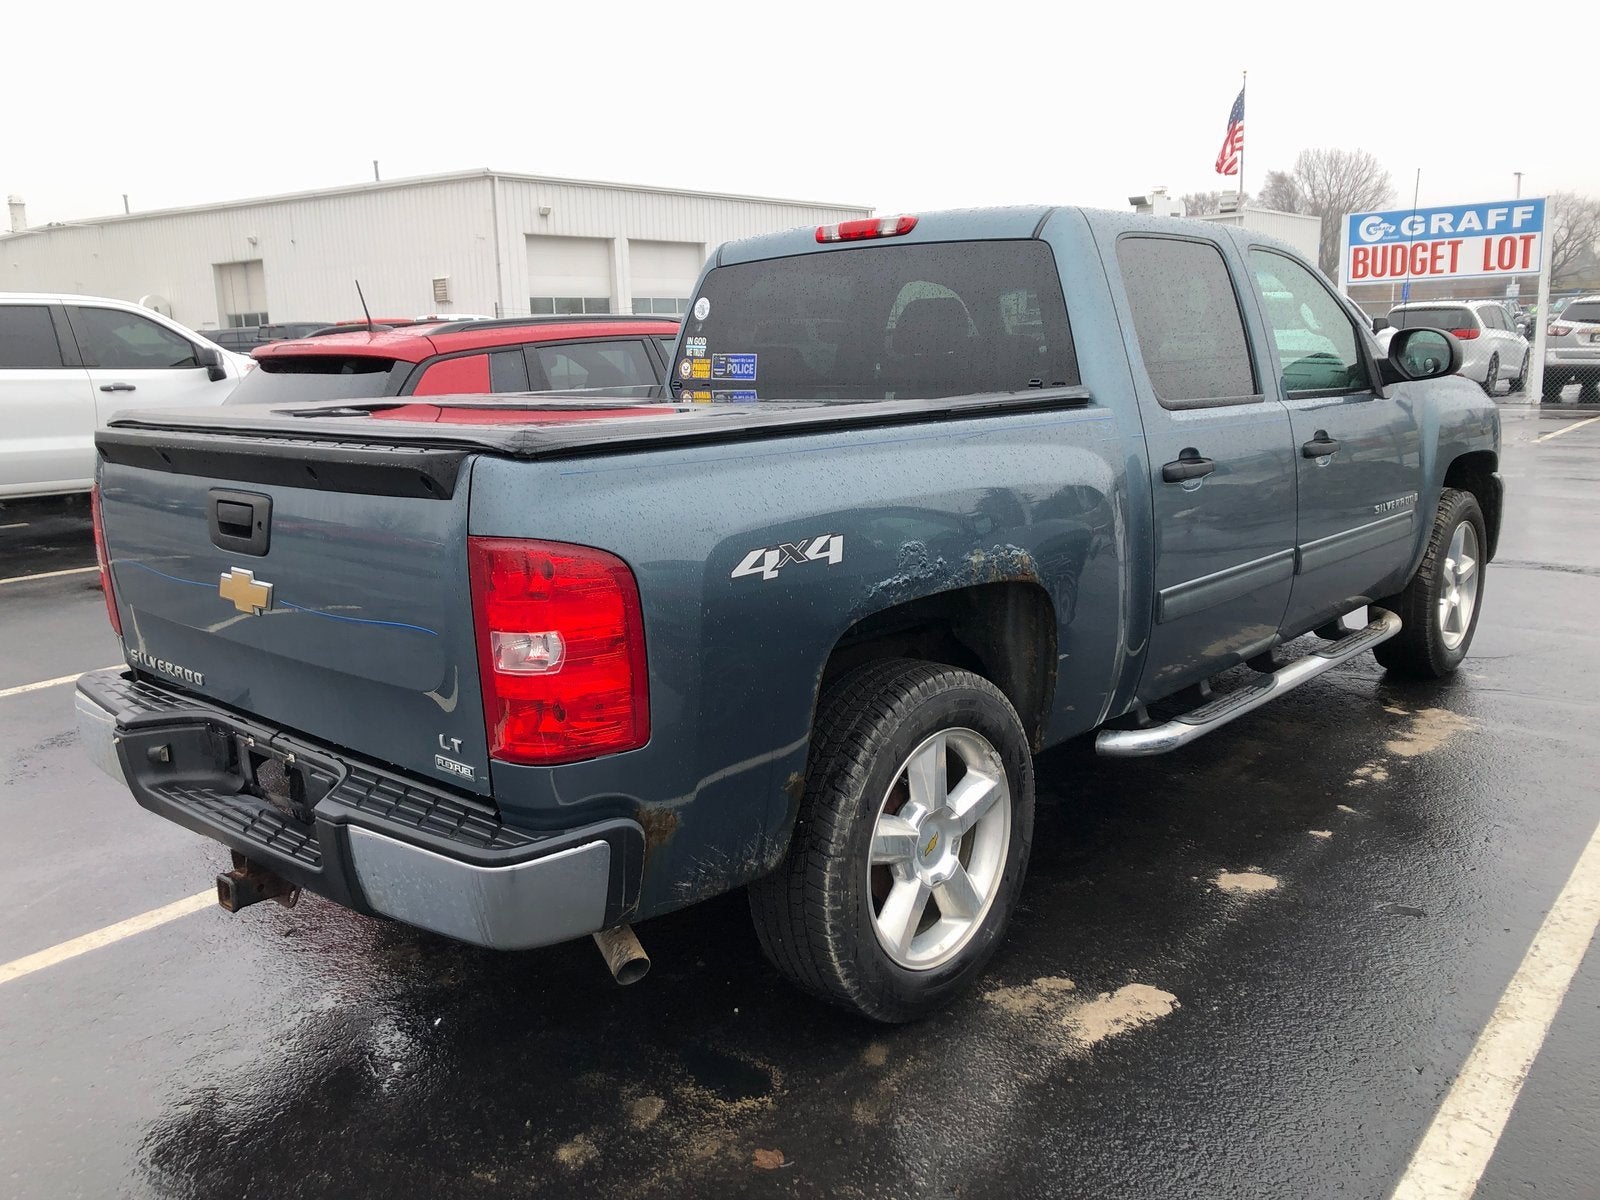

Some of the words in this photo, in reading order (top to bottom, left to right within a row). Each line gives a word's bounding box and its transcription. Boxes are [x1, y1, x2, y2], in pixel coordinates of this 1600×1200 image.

[1400, 205, 1535, 236] GRAFF
[1352, 239, 1464, 279] BUDGET
[1482, 234, 1536, 272] LOT
[687, 336, 694, 345] IN
[694, 336, 707, 346] GOD
[727, 363, 754, 375] POLICE
[1374, 494, 1414, 514] SILVERADO
[130, 649, 204, 686] SILVERADO
[438, 733, 463, 754] LT
